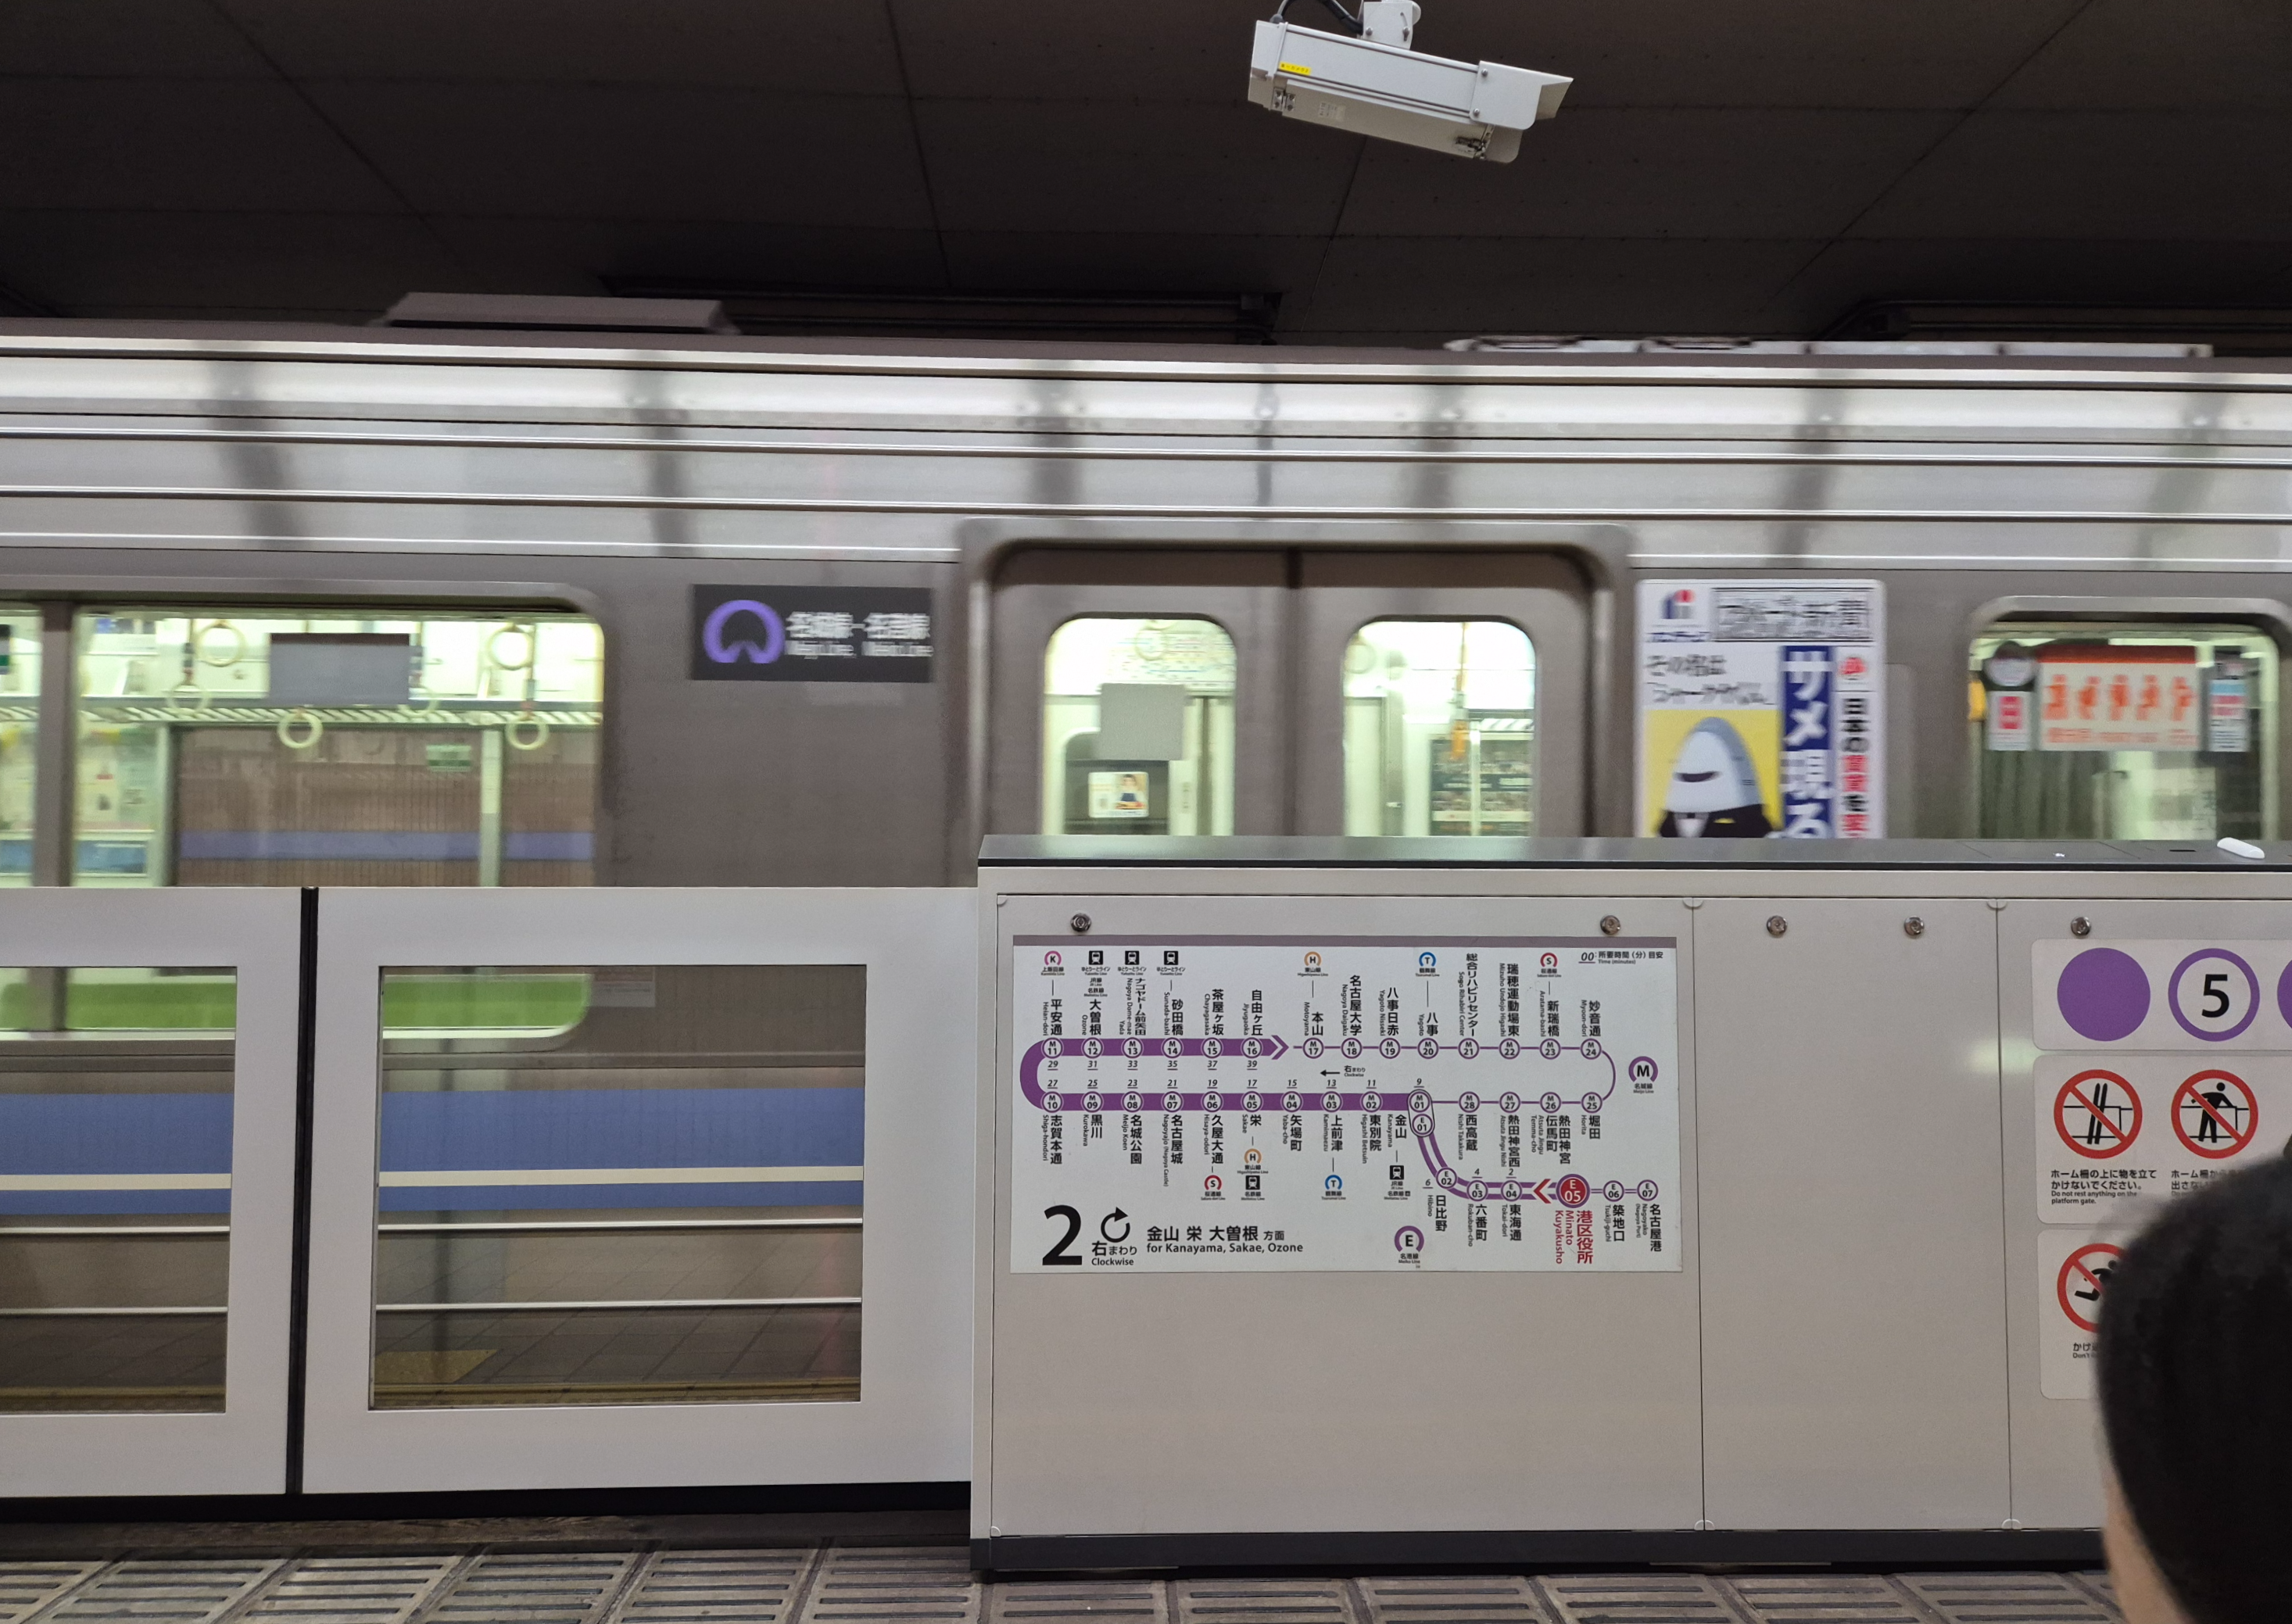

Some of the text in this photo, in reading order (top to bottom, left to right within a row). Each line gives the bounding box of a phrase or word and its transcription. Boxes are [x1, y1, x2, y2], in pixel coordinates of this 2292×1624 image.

[1781, 650, 1833, 838] サメ現る
[1350, 975, 1362, 1036] 名古屋大学
[1388, 988, 1398, 1036] 八事日赤
[1467, 953, 1478, 1036] 総合リハビリセンター
[1507, 964, 1519, 1036] 瑞穂運動場東
[2202, 974, 2229, 1018] 5
[1051, 1000, 1062, 1036] 平安通
[1172, 999, 1183, 1036] 砂田橋
[1312, 1012, 1323, 1036] 本山
[1427, 1013, 1438, 1036] 八事
[1548, 1000, 1559, 1036] 新瑞橋
[1589, 1000, 1601, 1036] 妙音通
[1328, 1079, 1336, 1088] 13
[1637, 1065, 1649, 1077] M
[1251, 1114, 1261, 1126] 栄
[1291, 1114, 1302, 1151] 矢場町
[1331, 1115, 1342, 1151] 上前津
[1370, 1114, 1381, 1150] 東別院
[1395, 1114, 1406, 1139] 金山
[1466, 1114, 1477, 1150] 西高蔵
[1589, 1115, 1600, 1139] 堀田
[1051, 1115, 1062, 1164] 志賀本通
[1130, 1114, 1142, 1164] 名城公園
[1171, 1114, 1183, 1164] 名古屋城
[1212, 1114, 1223, 1164] 久屋大通
[1508, 1115, 1520, 1167] 熱田神宮西
[1441, 1178, 1453, 1186] 02
[1470, 1190, 1482, 1200] 03
[1504, 1190, 1518, 1200] 04
[1563, 1191, 1581, 1203] 05
[1570, 1180, 1576, 1189] E
[1607, 1191, 1619, 1200] 06
[1641, 1190, 1653, 1199] 07
[1435, 1196, 1447, 1232] 日比野
[1476, 1204, 1487, 1241] 六番町
[1509, 1204, 1521, 1240] 東海通
[1566, 1211, 1574, 1245] Minato
[1613, 1204, 1624, 1241] 築地口
[1649, 1204, 1661, 1251] 名古屋港
[1043, 1205, 1082, 1265] 2
[1092, 1241, 1137, 1256] 右まわり
[1147, 1243, 1303, 1254] for Kanayama, Sakae, Ozone
[1148, 1225, 1284, 1241] 金山 栄 大曽根 方面
[1406, 1235, 1413, 1247] E
[1553, 1211, 1564, 1264] Kuyakusho
[1577, 1211, 1593, 1264] 港区役所
